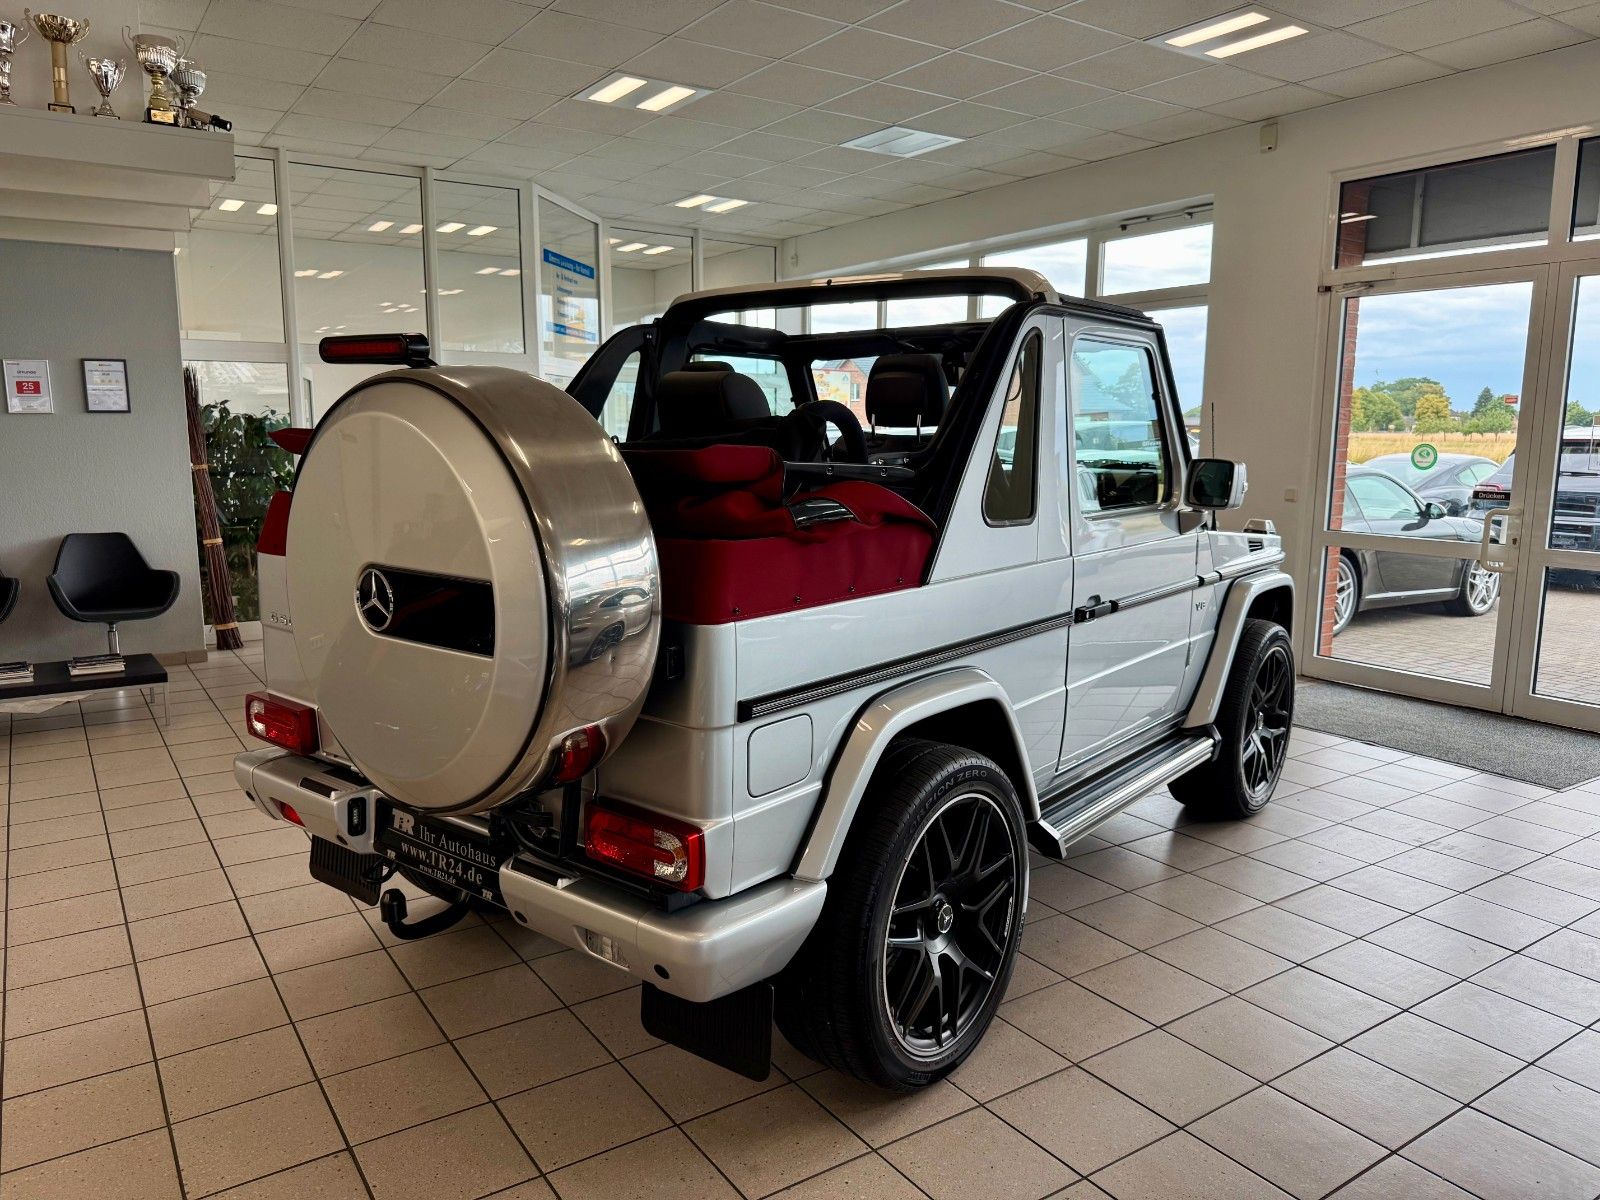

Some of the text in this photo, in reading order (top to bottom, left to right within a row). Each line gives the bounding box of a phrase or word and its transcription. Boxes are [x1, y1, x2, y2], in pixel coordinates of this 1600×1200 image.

[22, 382, 35, 390] 25
[1478, 491, 1505, 500] Drücken
[956, 769, 988, 782] ZERO
[419, 824, 497, 868] Ihr Autohaus
[401, 841, 483, 885] www.TR24.de
[419, 864, 457, 885] www.TR24.de
